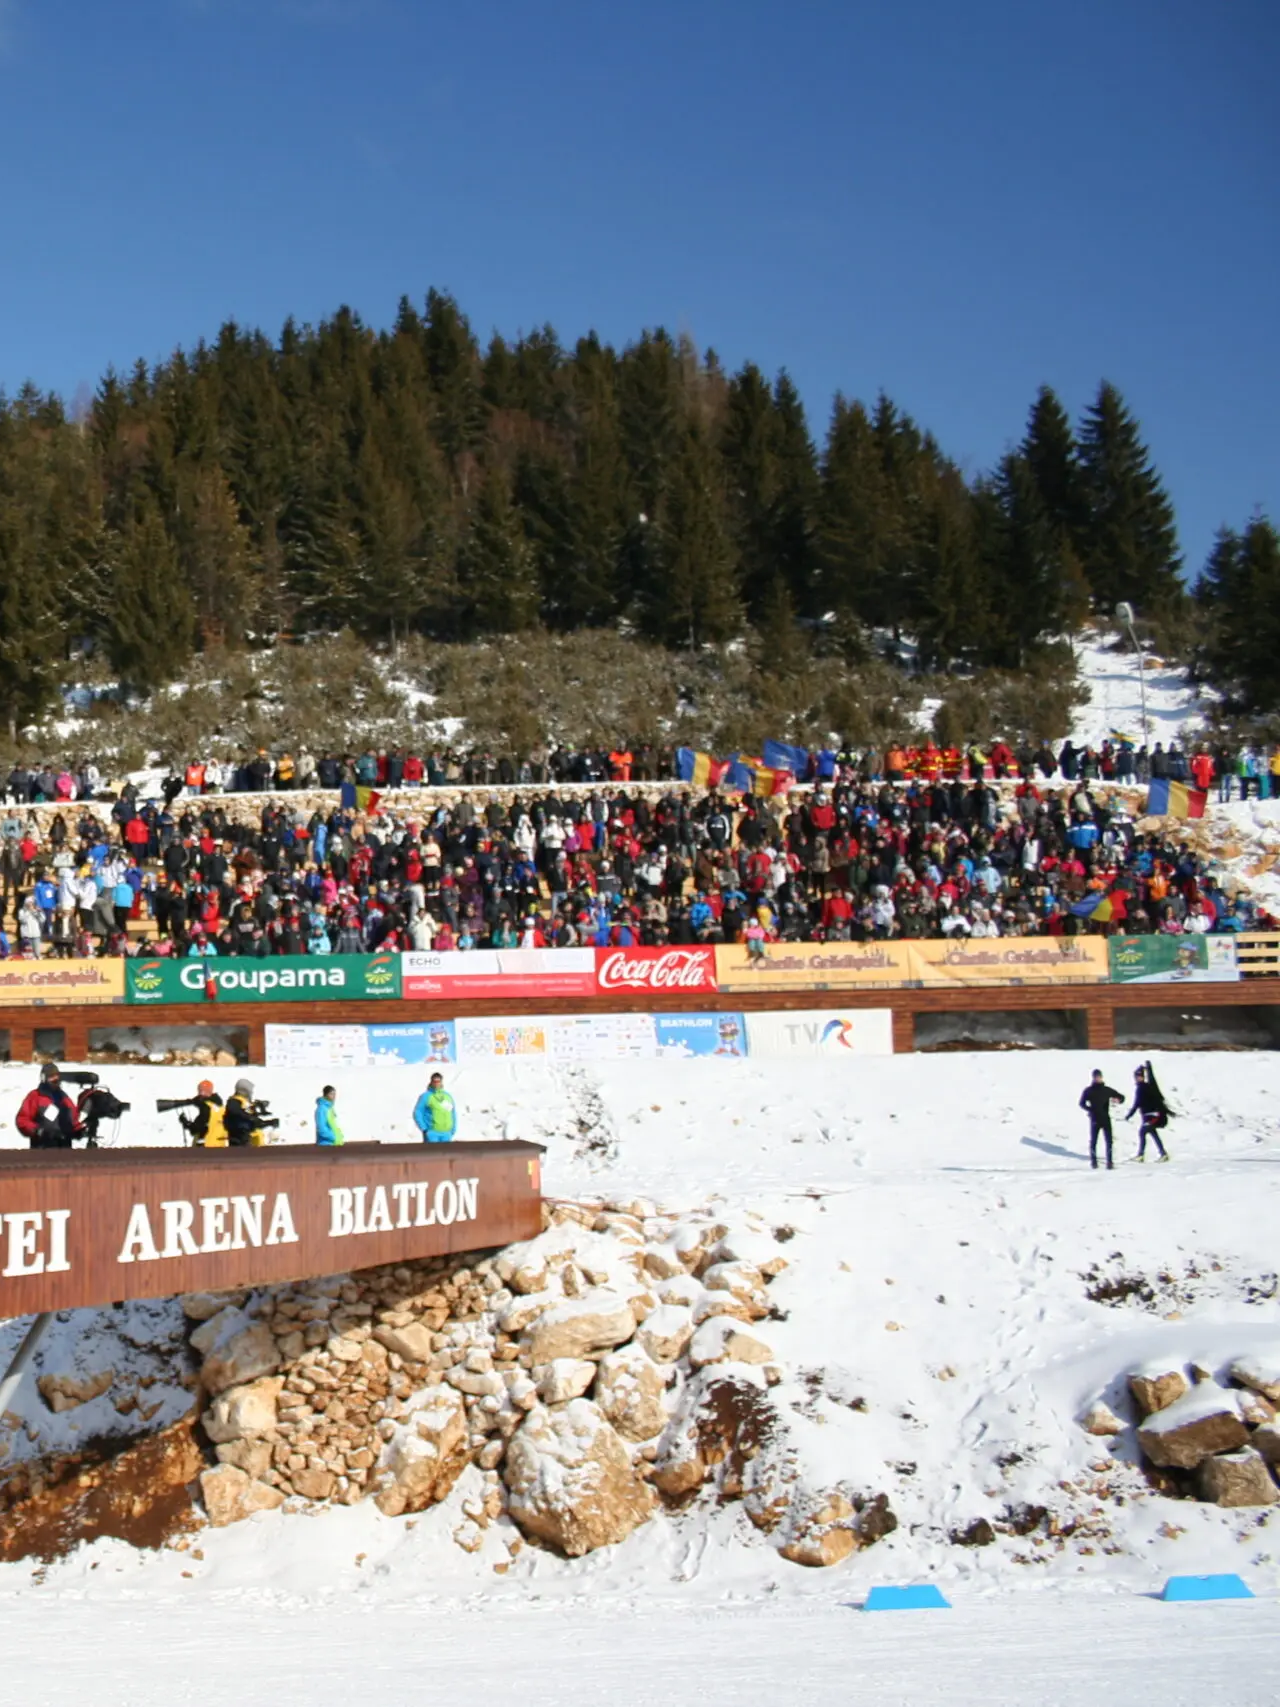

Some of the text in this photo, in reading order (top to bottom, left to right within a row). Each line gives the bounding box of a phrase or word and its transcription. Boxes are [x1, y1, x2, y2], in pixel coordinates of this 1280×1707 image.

[180, 963, 346, 994] Groupama
[409, 958, 441, 966] ECHO
[598, 951, 710, 988] Coca-Cola
[117, 1193, 299, 1263] ARENA
[329, 1178, 479, 1237] BIATLON
